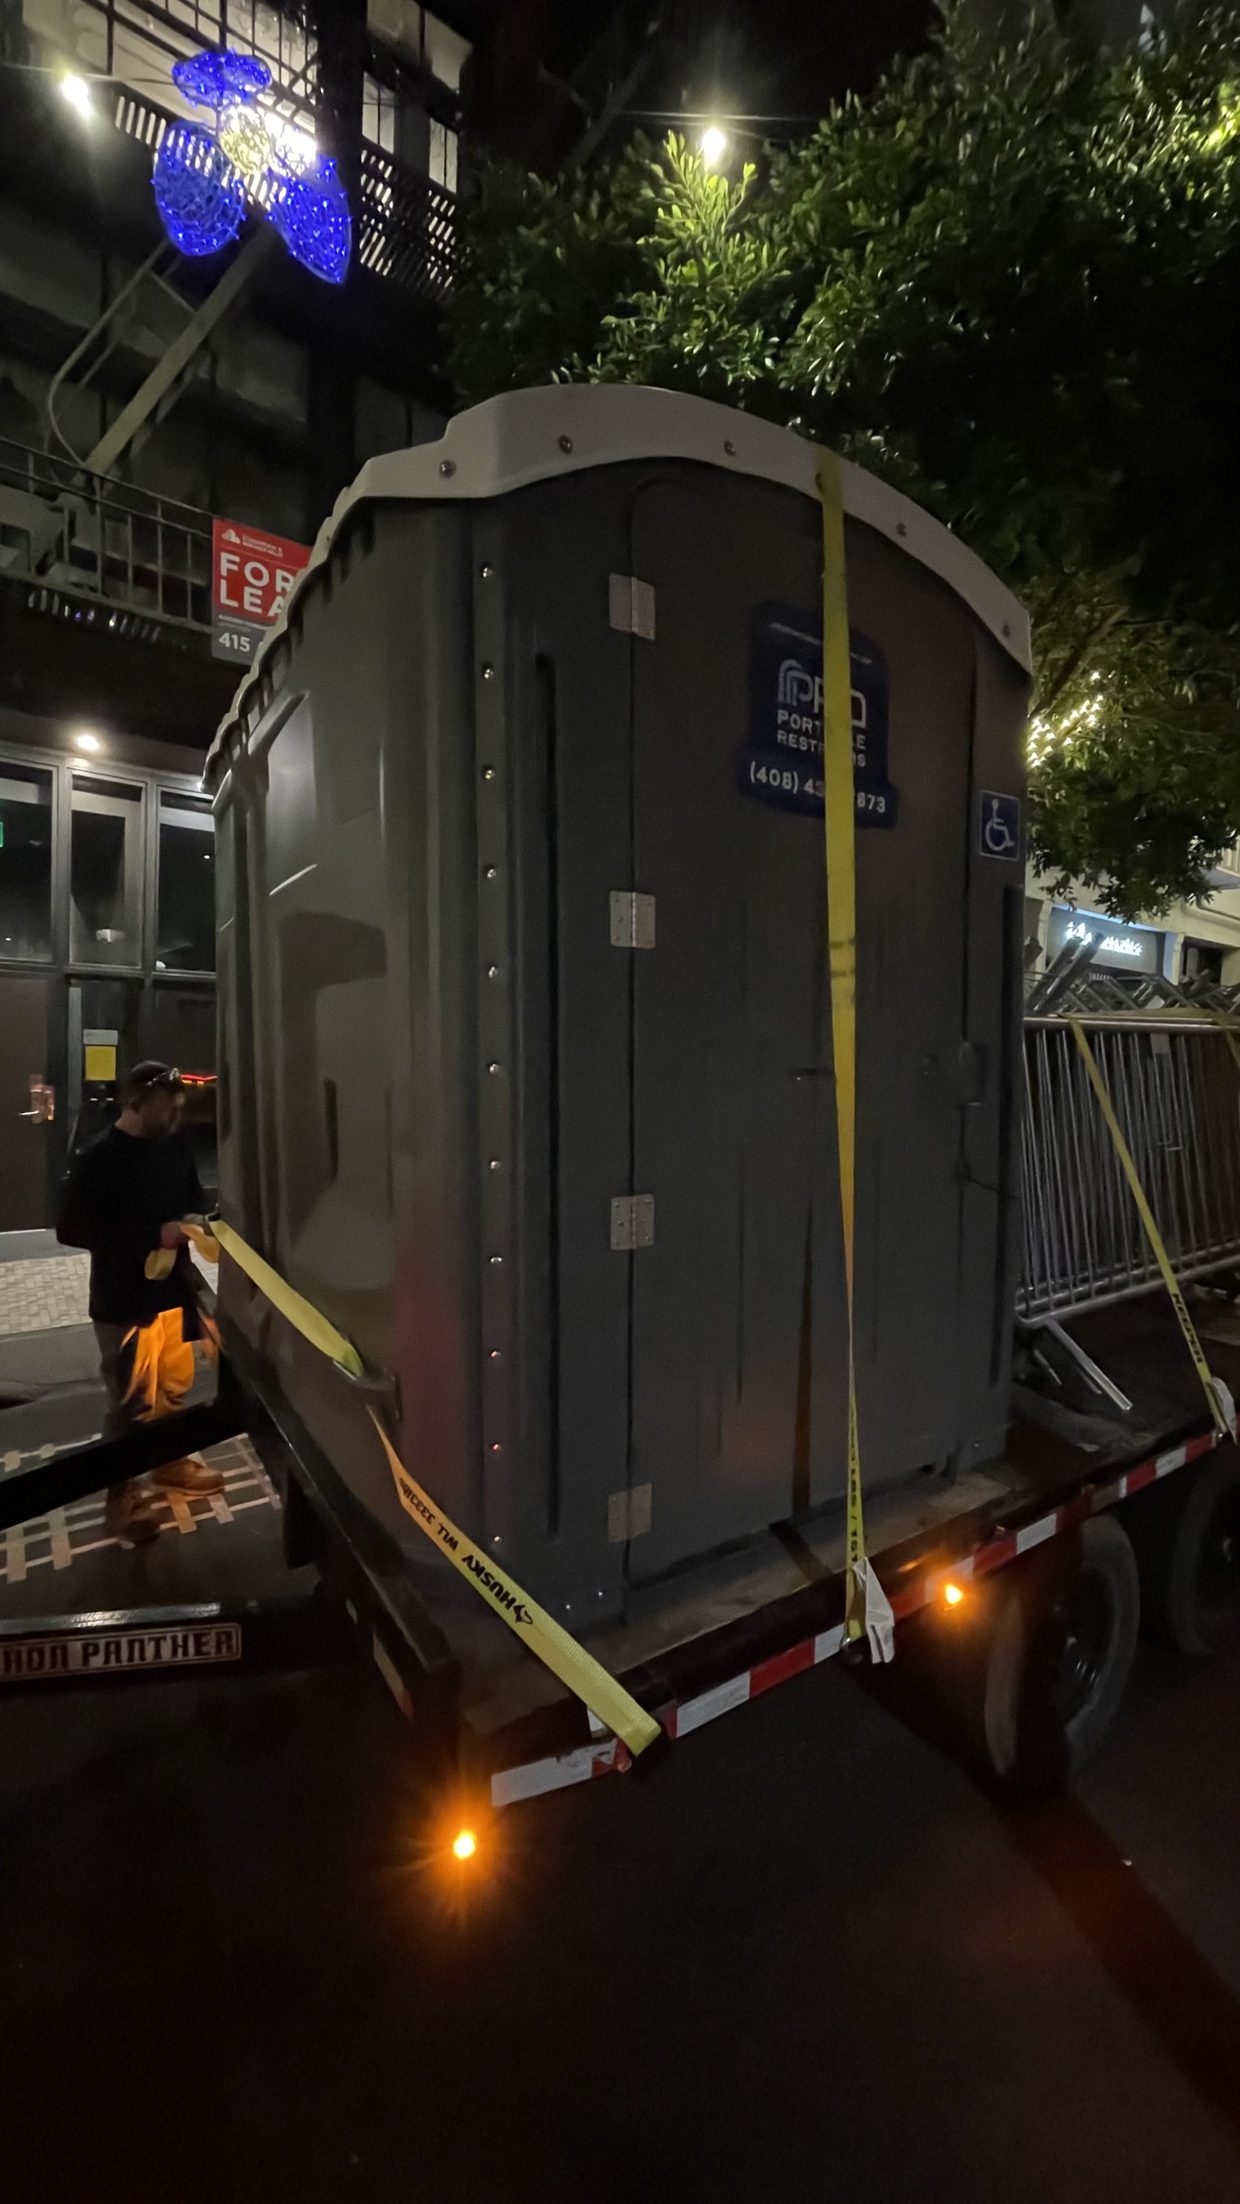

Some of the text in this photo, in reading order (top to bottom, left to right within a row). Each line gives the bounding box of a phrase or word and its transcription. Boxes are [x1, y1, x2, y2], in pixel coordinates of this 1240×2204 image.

[220, 551, 295, 594] FOR
[220, 579, 285, 617] LEA
[219, 632, 251, 653] 415
[776, 729, 867, 768] RESTS
[777, 708, 867, 751] PORTE
[750, 759, 799, 795] (408)
[438, 1522, 459, 1551] WLL
[461, 1554, 517, 1611] HUSKY
[3, 1629, 233, 1674] RON PANTHER
